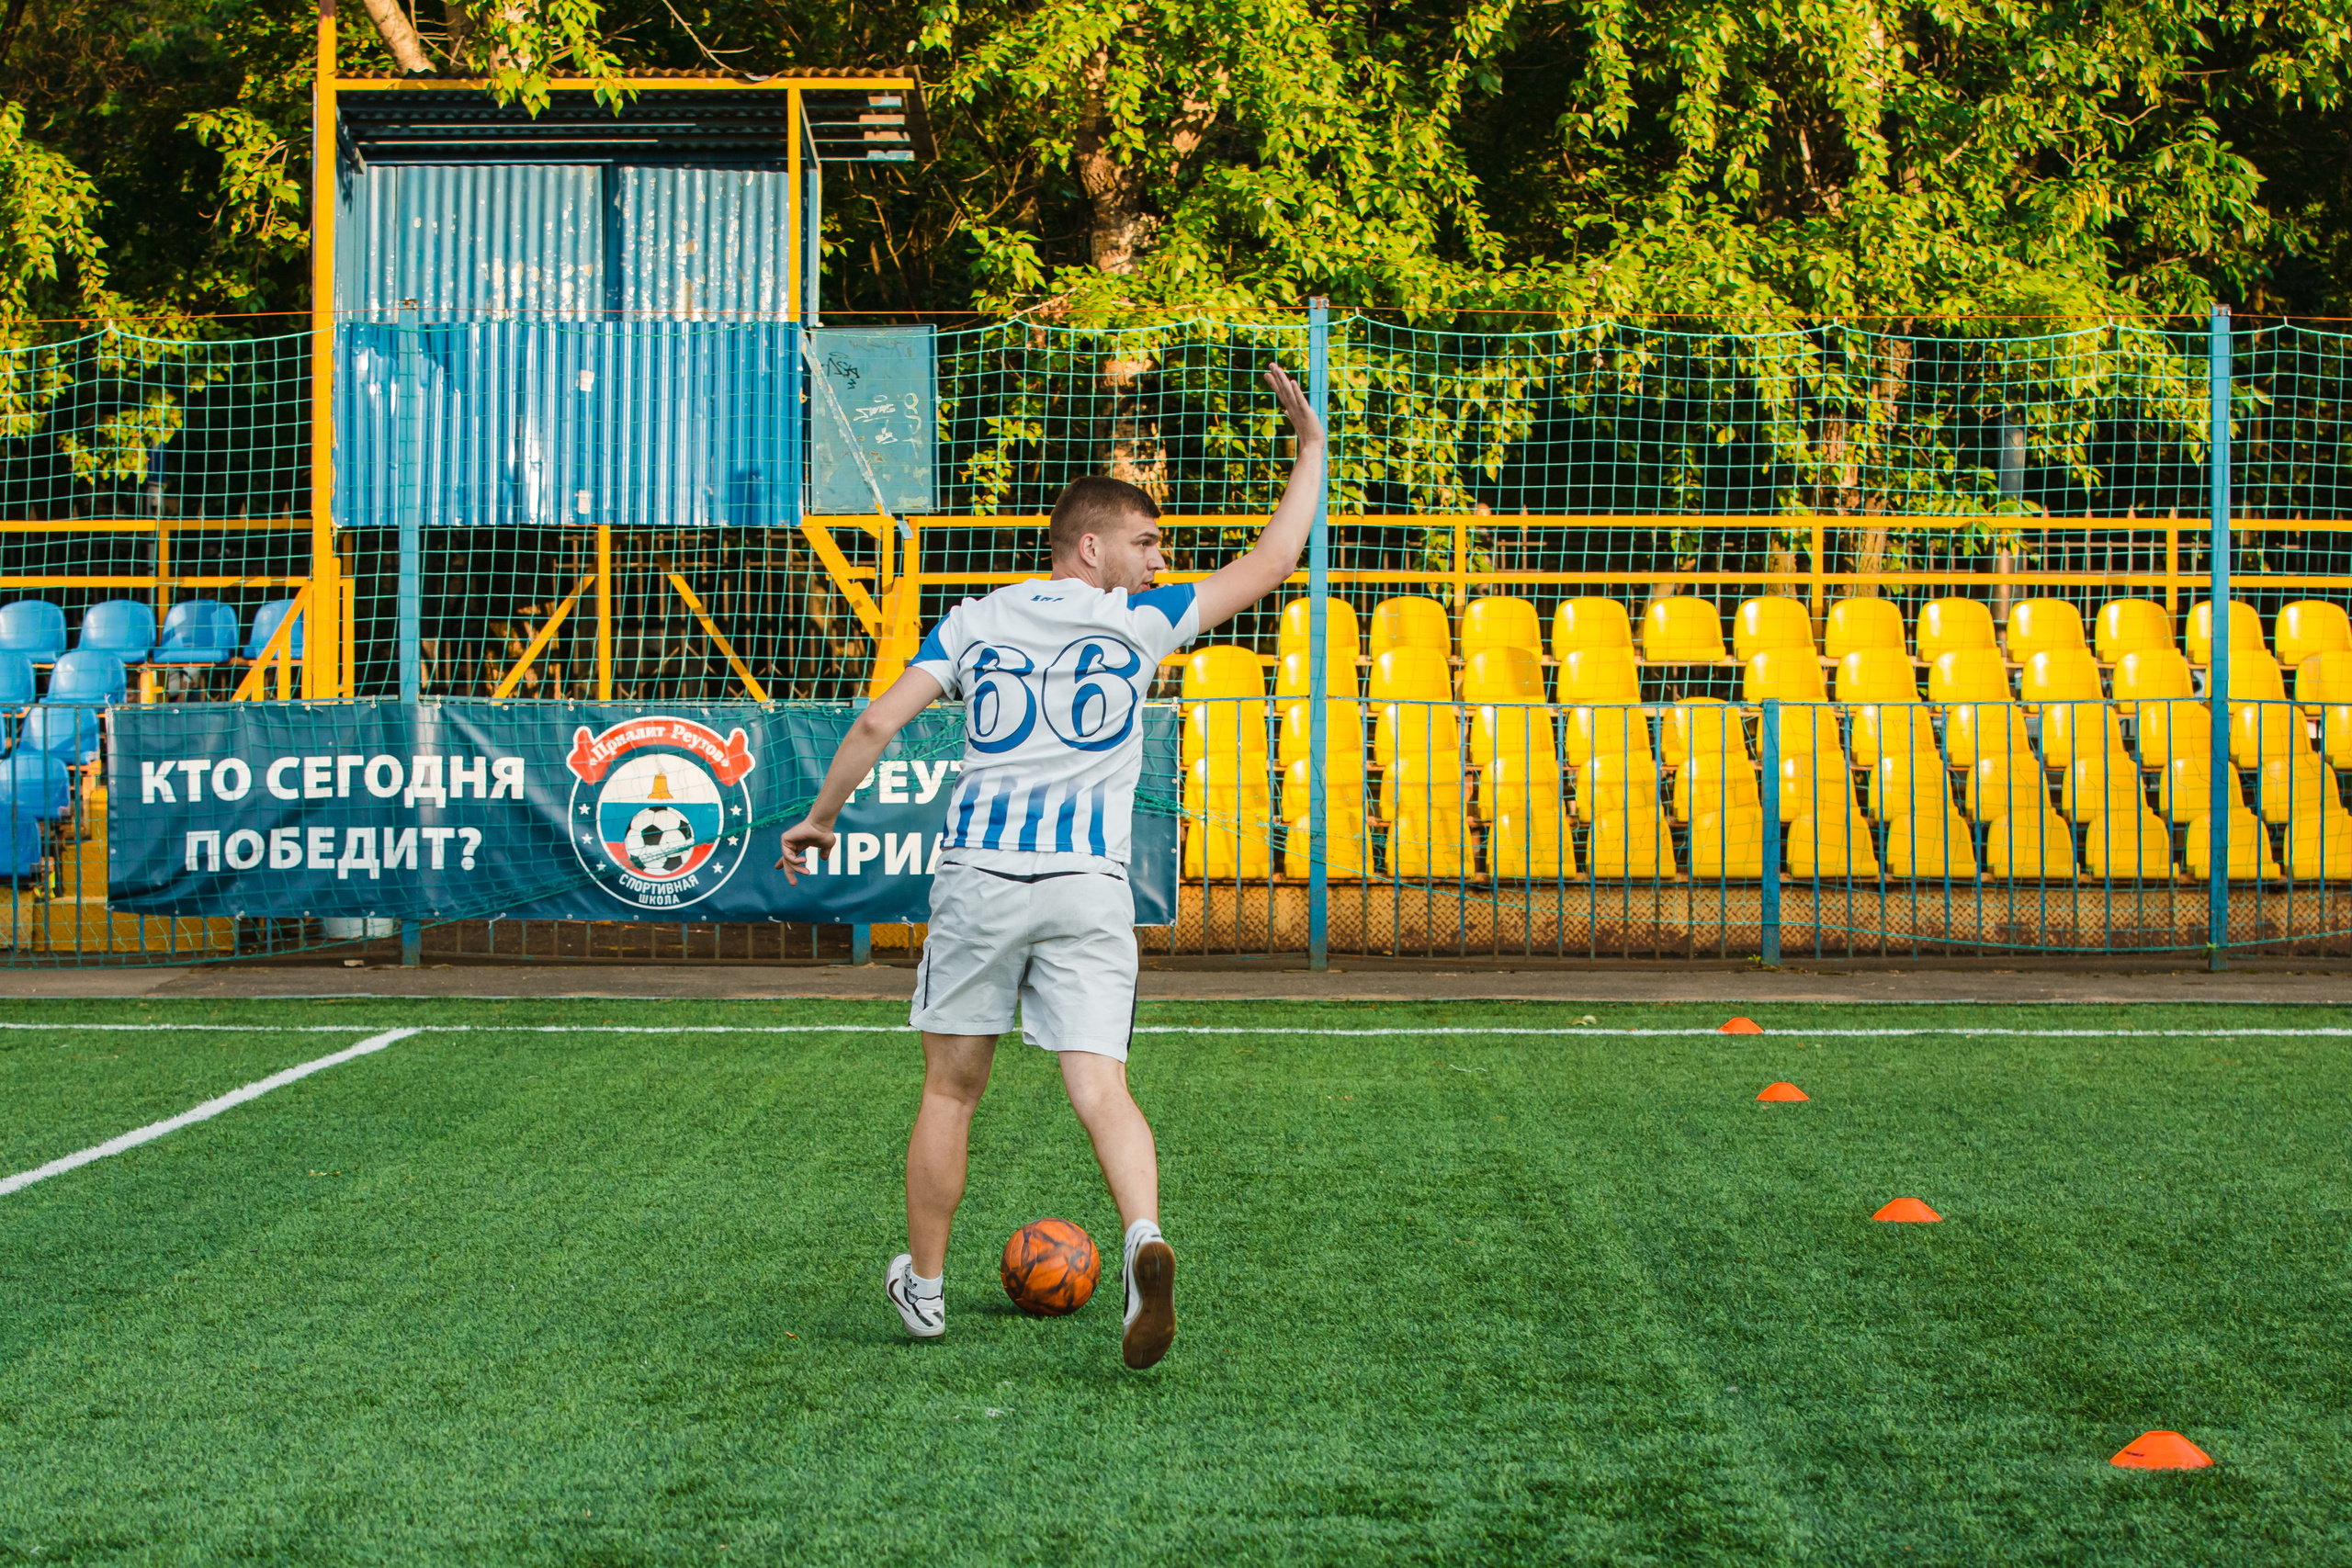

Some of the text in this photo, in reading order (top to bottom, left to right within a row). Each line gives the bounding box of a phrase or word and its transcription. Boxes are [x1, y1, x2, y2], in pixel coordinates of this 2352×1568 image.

[956, 635, 1141, 753] 66
[141, 754, 525, 807] КТО СЕГОДНЯ
[186, 827, 482, 879] ПОБЕДИТ?
[618, 873, 699, 895] СПОРТИВНАЯ
[639, 894, 680, 906] ШКОЛА
